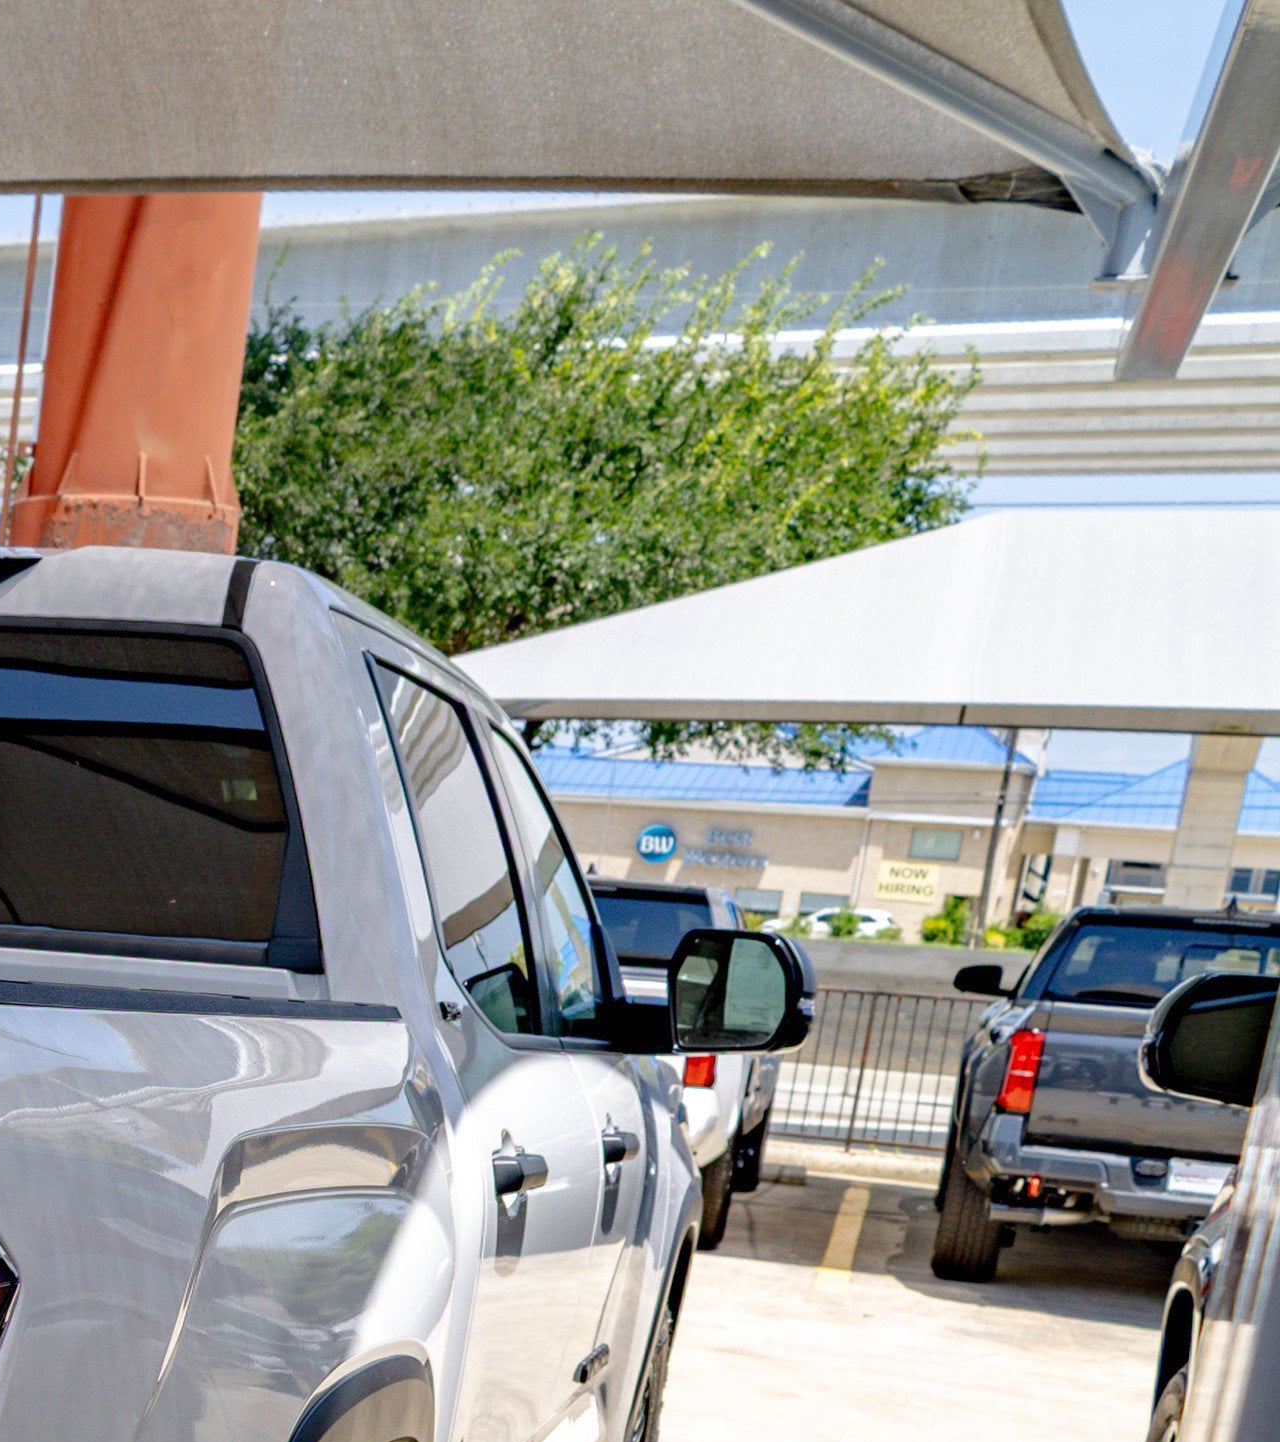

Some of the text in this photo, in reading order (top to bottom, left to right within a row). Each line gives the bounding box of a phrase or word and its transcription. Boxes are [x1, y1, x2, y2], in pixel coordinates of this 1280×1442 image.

[640, 836, 675, 854] BW
[890, 867, 930, 880] NOW
[878, 883, 934, 897] HIRING
